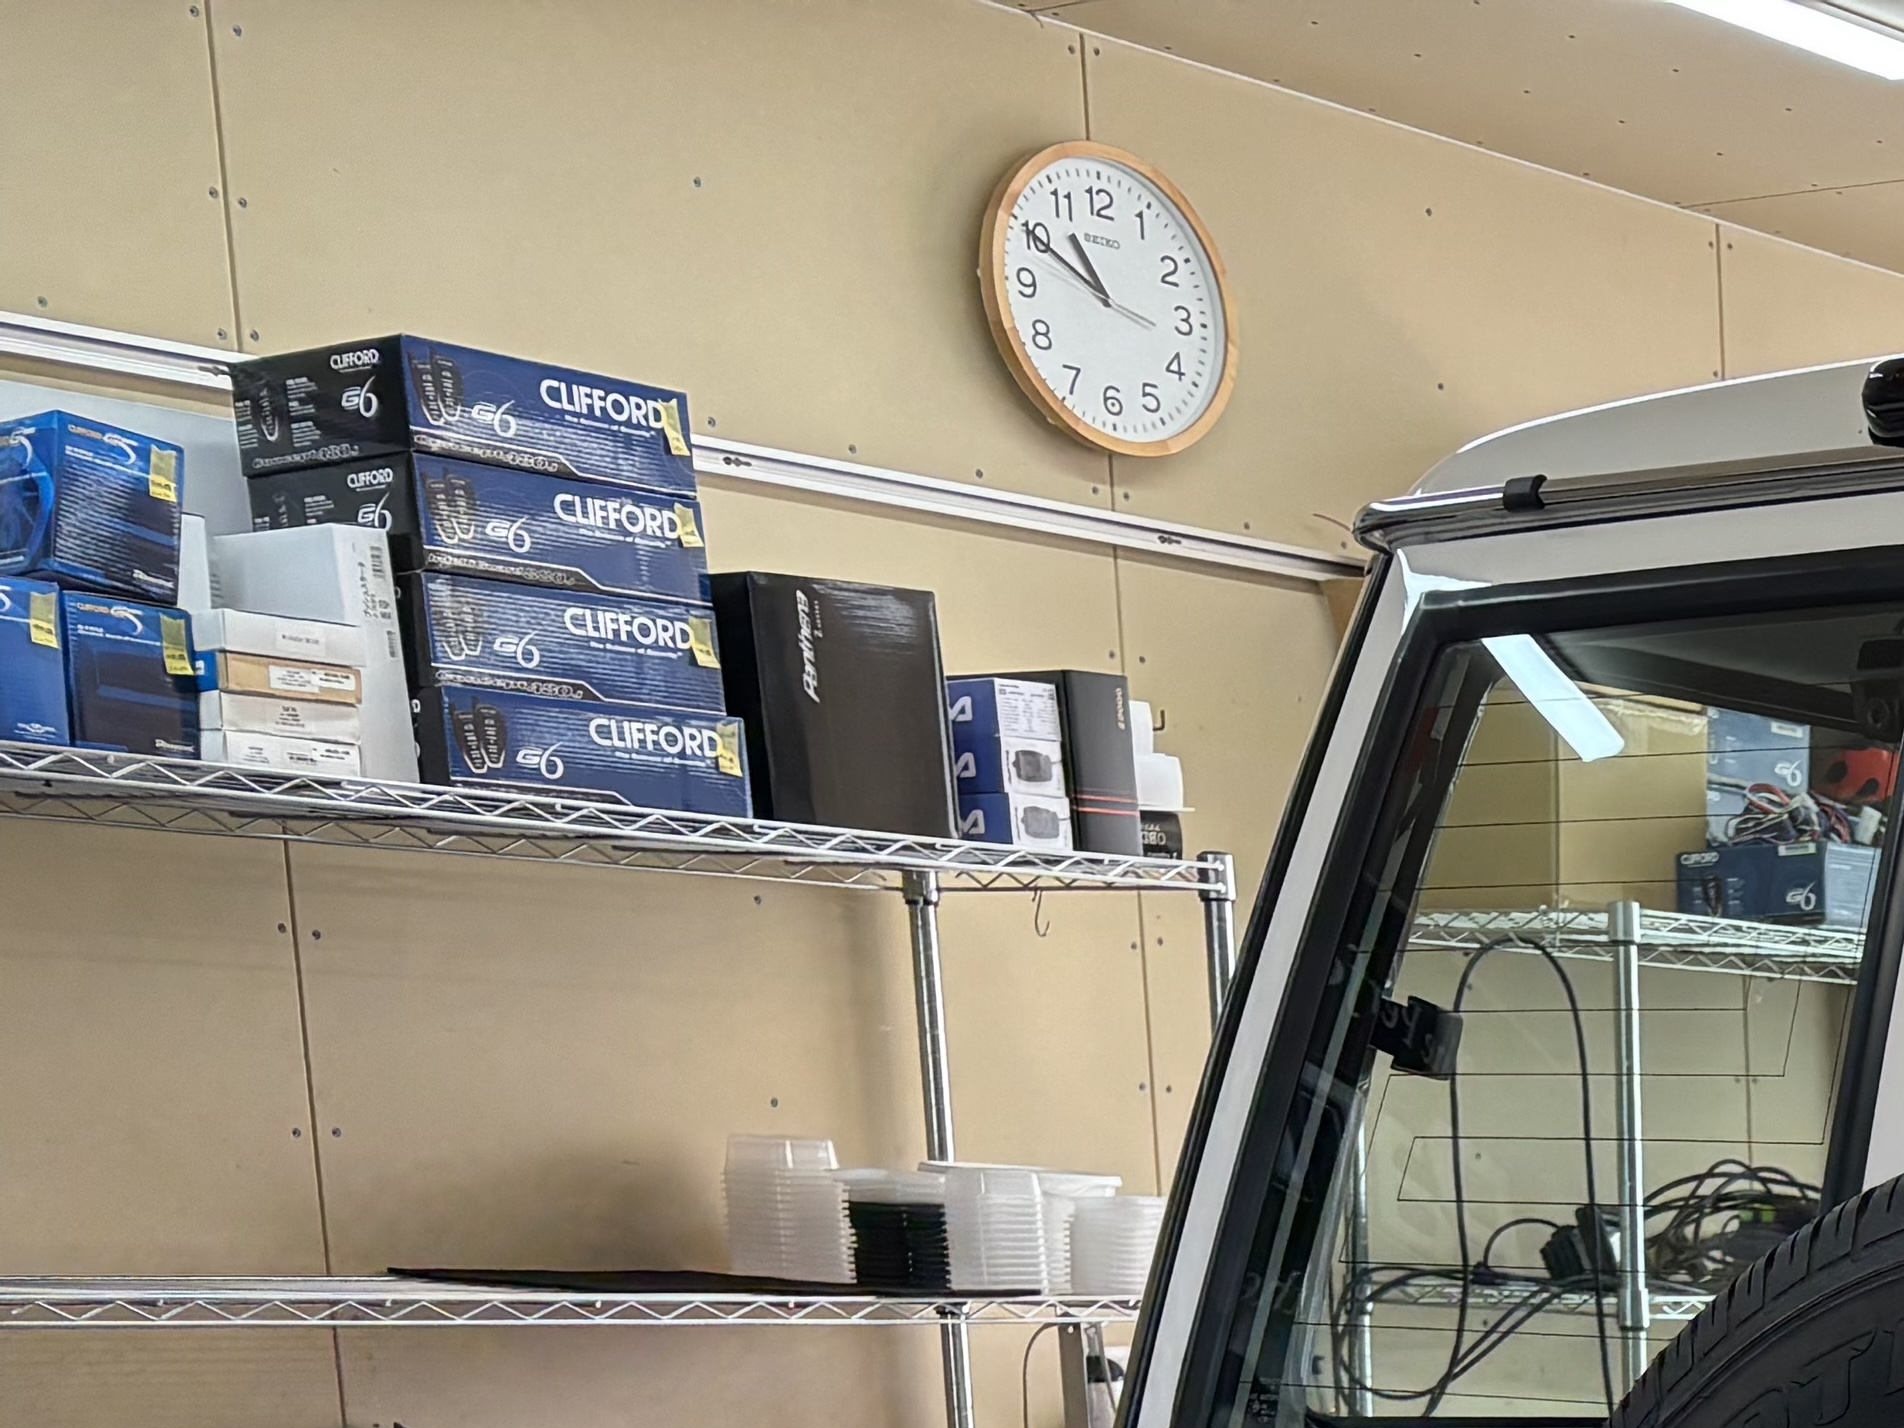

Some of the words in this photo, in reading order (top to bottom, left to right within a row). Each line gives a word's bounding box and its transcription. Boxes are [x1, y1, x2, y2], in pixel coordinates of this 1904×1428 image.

[1050, 187, 1073, 222] 11
[1085, 185, 1115, 221] 12
[1021, 219, 1051, 253] 10
[1083, 232, 1121, 250] SEIKO
[1135, 210, 1145, 240] 1
[1016, 267, 1037, 298] 9
[1160, 255, 1180, 287] 2
[1032, 319, 1052, 350] 8
[1174, 305, 1193, 336] 3
[330, 349, 379, 370] CLIFFORD
[1165, 352, 1186, 381] 4
[1062, 364, 1081, 395] 7
[341, 376, 378, 418] G6
[540, 379, 667, 429] CLIFFORD
[1103, 385, 1123, 416] 6
[1141, 382, 1161, 413] 5
[471, 400, 517, 437] G6
[347, 468, 393, 488] CLIFFORD
[357, 492, 393, 530] G6
[554, 493, 681, 539] CLIFFORD
[485, 515, 531, 553] G6
[564, 607, 692, 649] CLIFFORD
[493, 631, 540, 668] G6
[589, 718, 722, 758] CLIFFORD
[516, 742, 564, 779] G6
